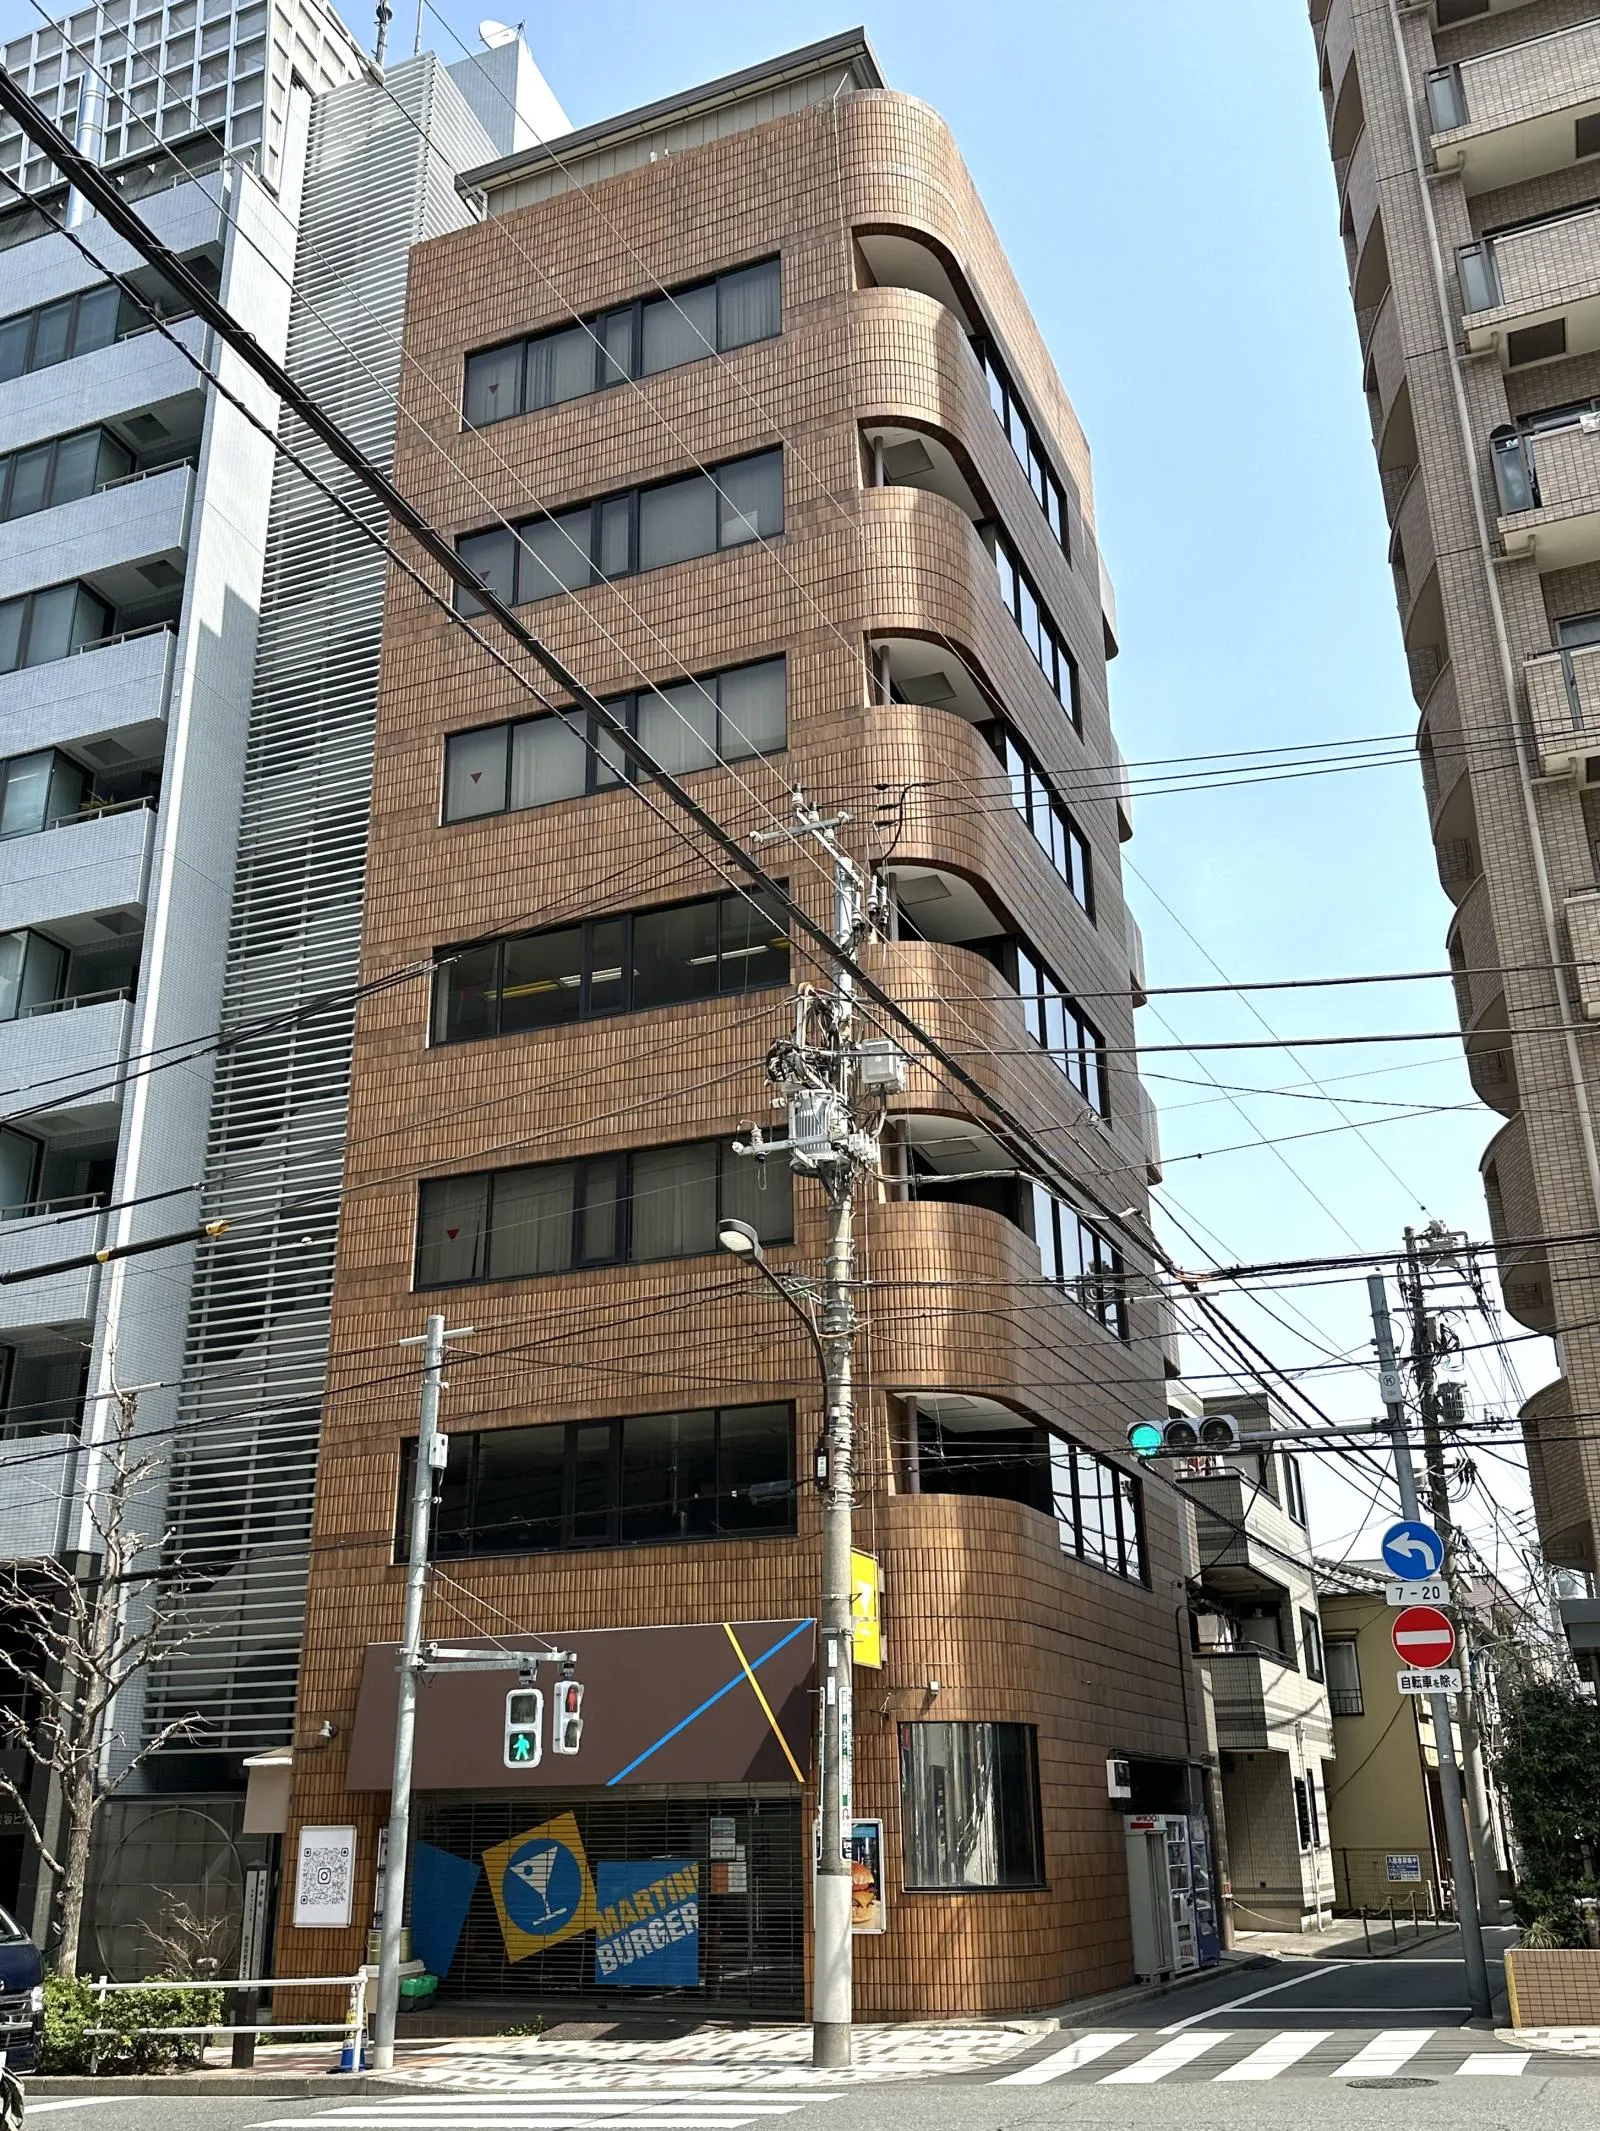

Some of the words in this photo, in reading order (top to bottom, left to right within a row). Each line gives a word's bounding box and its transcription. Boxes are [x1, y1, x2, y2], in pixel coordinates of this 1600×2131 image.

[1400, 1674, 1459, 1689] 自転車を除く
[596, 1902, 698, 1975] BURGER
